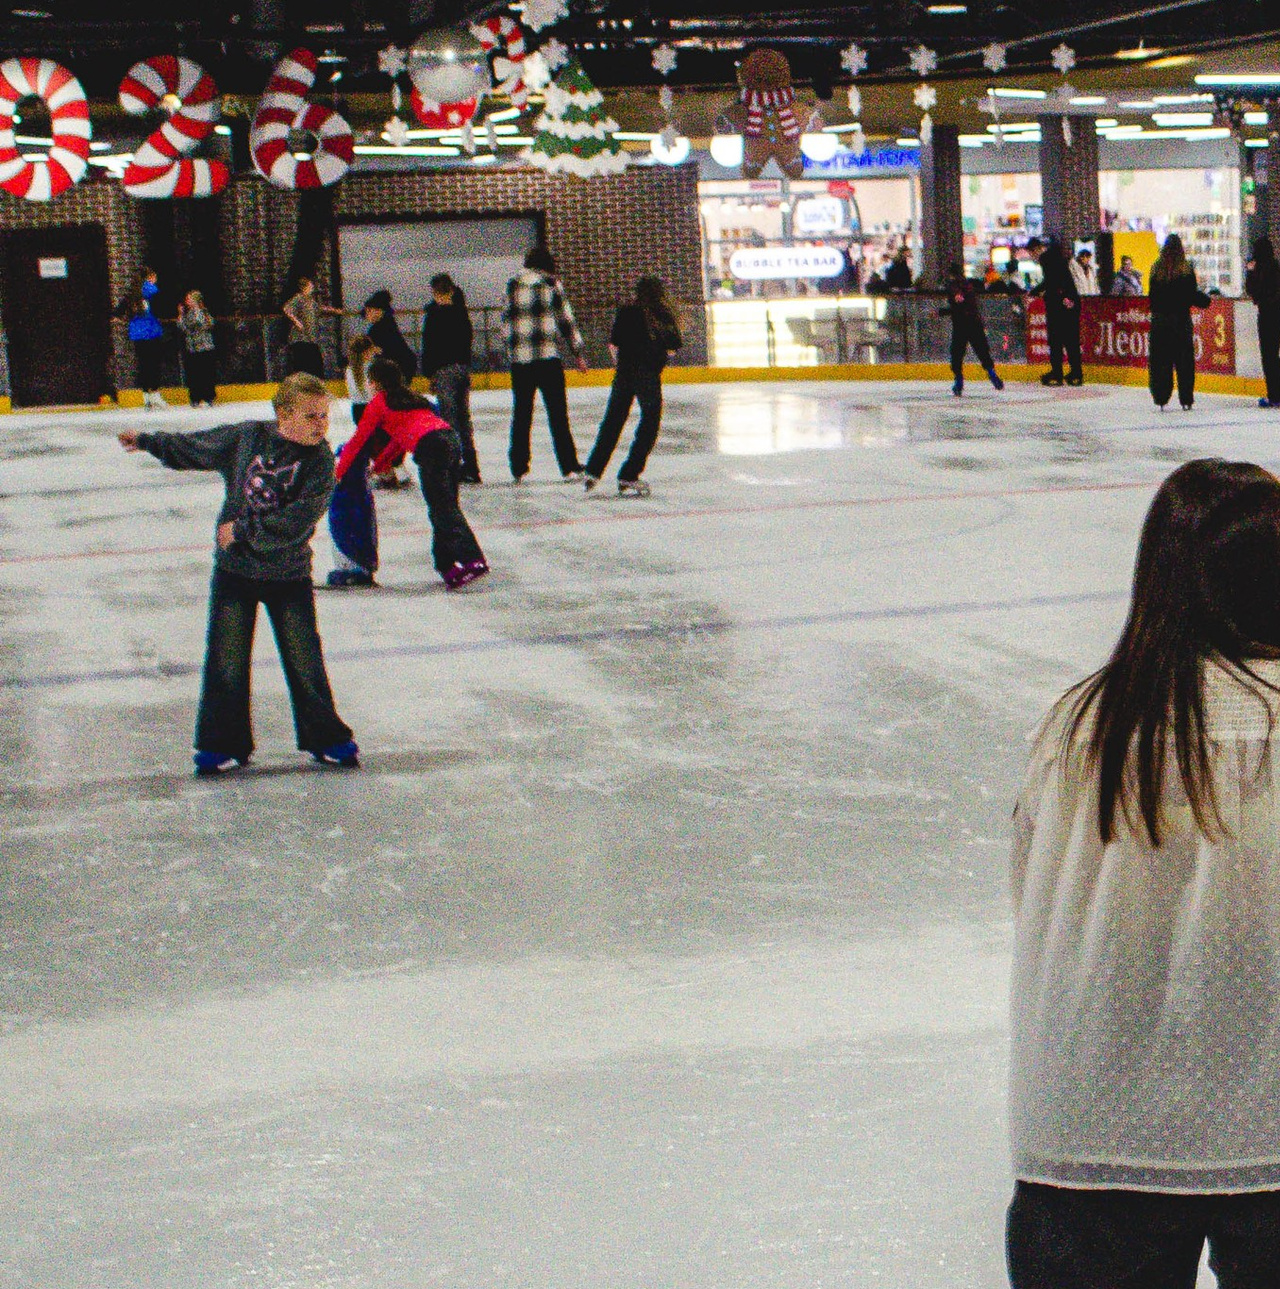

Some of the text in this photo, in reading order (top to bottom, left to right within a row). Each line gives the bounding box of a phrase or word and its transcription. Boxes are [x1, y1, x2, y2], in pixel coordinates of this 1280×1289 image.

[735, 257, 837, 269] BUBBLE TEA BAR
[1213, 314, 1226, 348] 3
